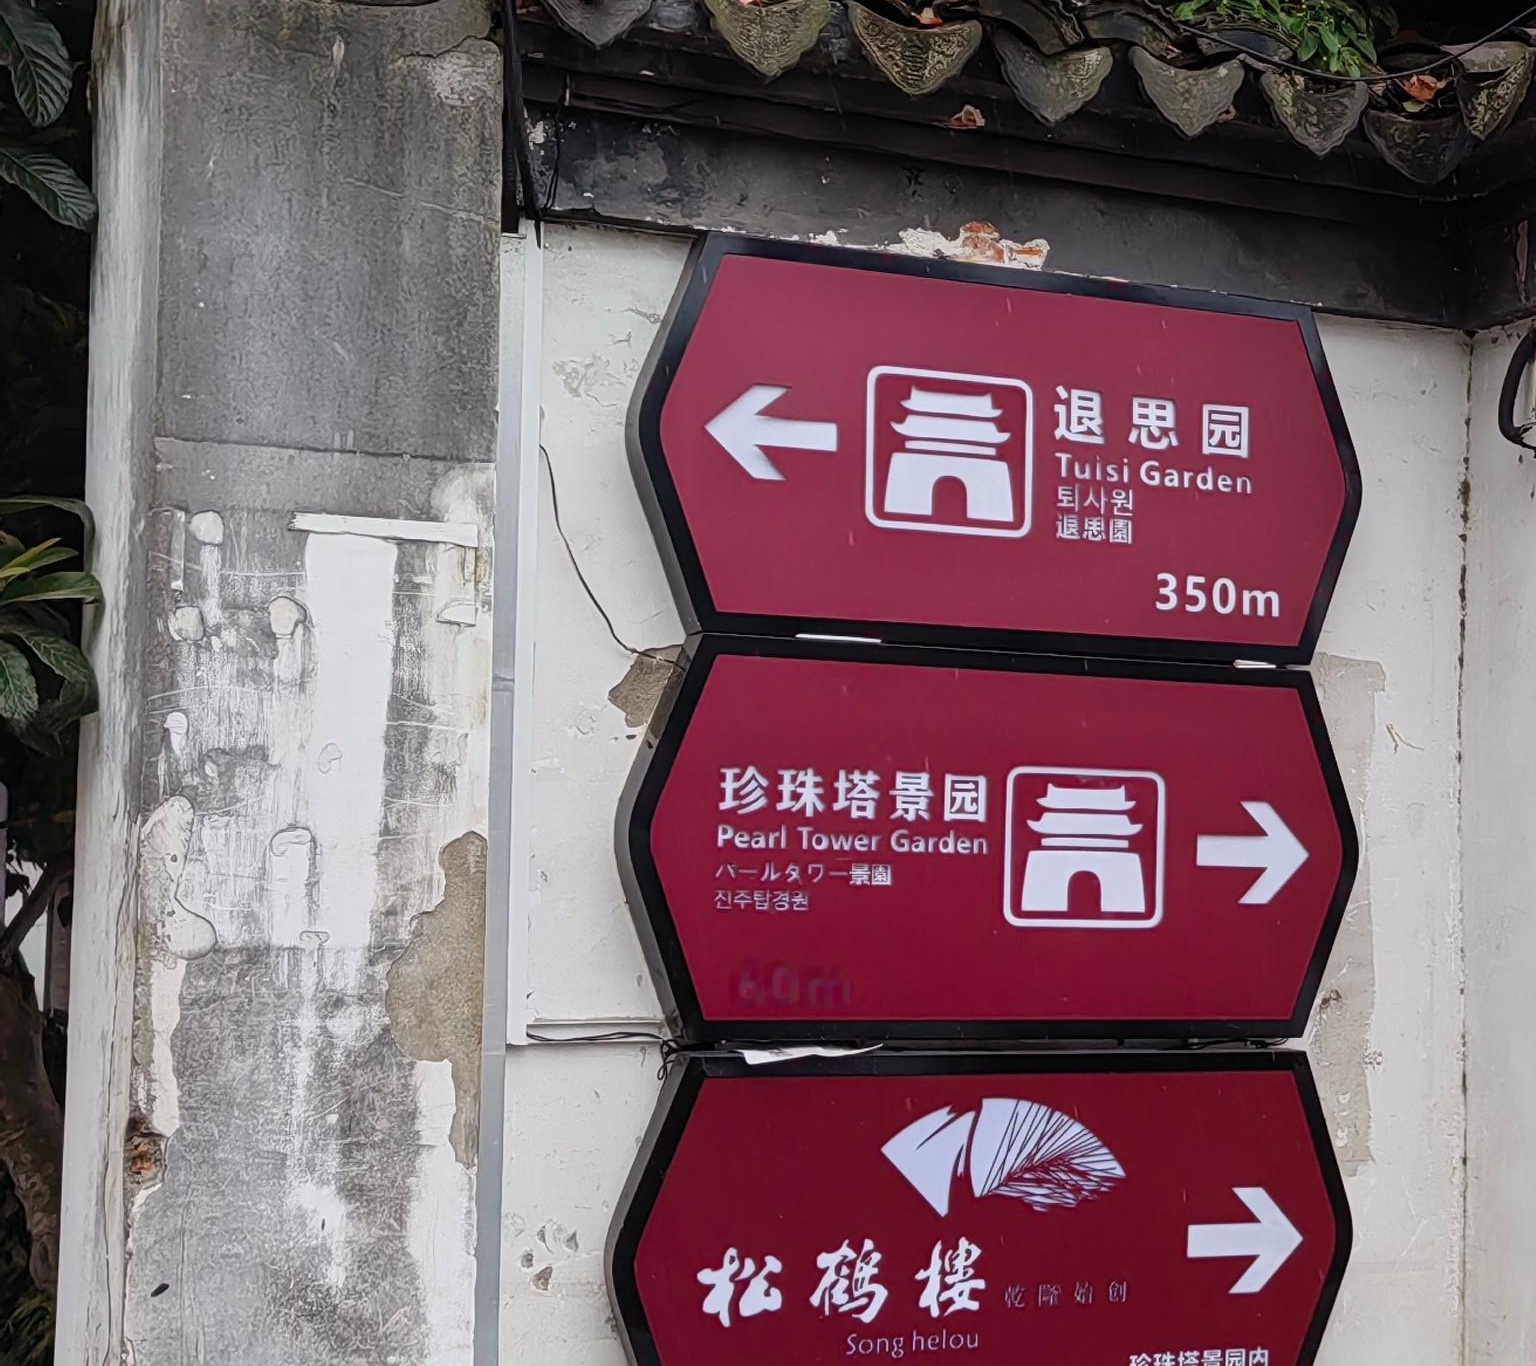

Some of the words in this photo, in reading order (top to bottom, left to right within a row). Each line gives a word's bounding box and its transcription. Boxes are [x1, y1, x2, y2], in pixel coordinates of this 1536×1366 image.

[1053, 385, 1250, 459] 退思园
[1054, 452, 1130, 484] Tuisi
[1139, 460, 1253, 495] Garden
[1056, 483, 1134, 516] 퇴사원
[1155, 572, 1281, 618] 350m
[718, 765, 988, 823] 珍珠塔景园
[717, 824, 787, 849] Pearl
[796, 826, 881, 852] Tower
[890, 829, 988, 855] Garden
[845, 1333, 904, 1359] Song
[912, 1328, 979, 1352] helou
